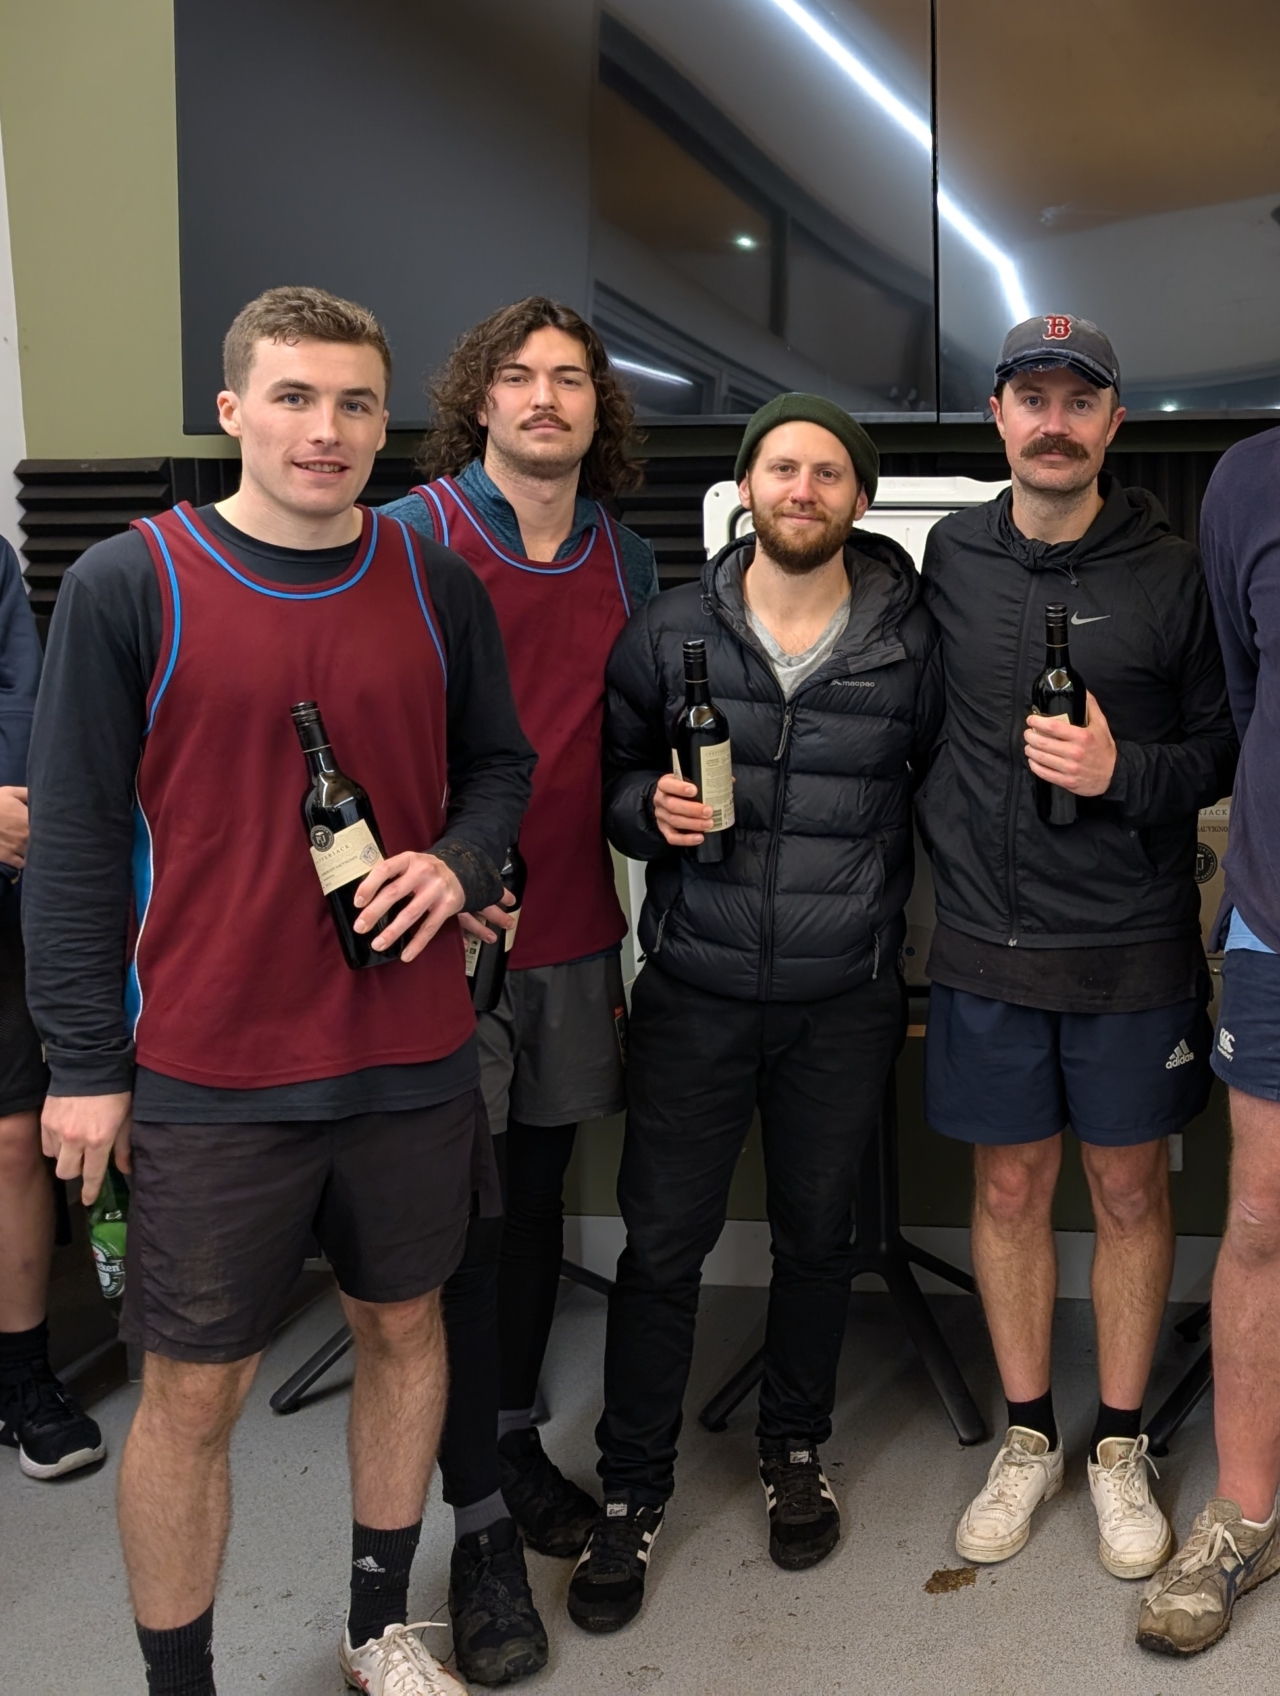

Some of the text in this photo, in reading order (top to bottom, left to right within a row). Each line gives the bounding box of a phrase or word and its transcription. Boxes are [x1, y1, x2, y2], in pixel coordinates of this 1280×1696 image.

[1043, 314, 1072, 341] B
[1198, 825, 1229, 833] AUVIGNO
[1165, 1051, 1195, 1069] adidas
